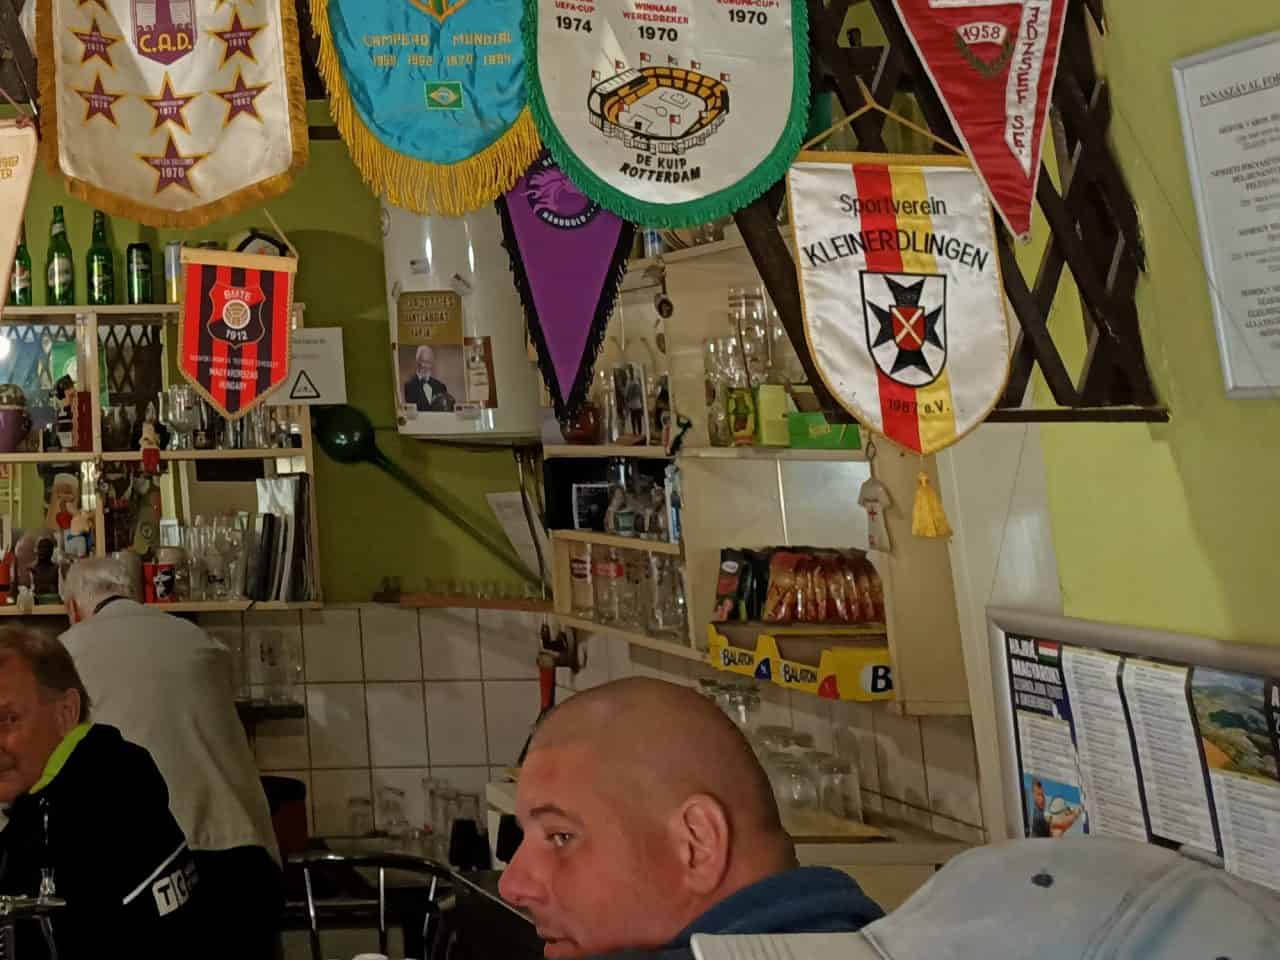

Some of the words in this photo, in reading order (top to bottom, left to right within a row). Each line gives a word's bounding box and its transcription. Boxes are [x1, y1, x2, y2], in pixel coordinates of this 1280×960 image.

[555, 16, 593, 34] 1974
[728, 8, 769, 26] 1970
[638, 26, 678, 42] 1970
[962, 24, 1001, 41] 1958
[138, 32, 194, 54] C.A.D.
[636, 153, 653, 166] DE
[657, 155, 688, 169] KUIP
[618, 163, 702, 185] ROTTERDAM
[839, 193, 947, 217] Sportverein
[802, 228, 989, 272] KLEINERDLINGEN
[225, 329, 248, 340] 1912
[722, 648, 754, 667] BALATON
[782, 663, 818, 684] BALATON
